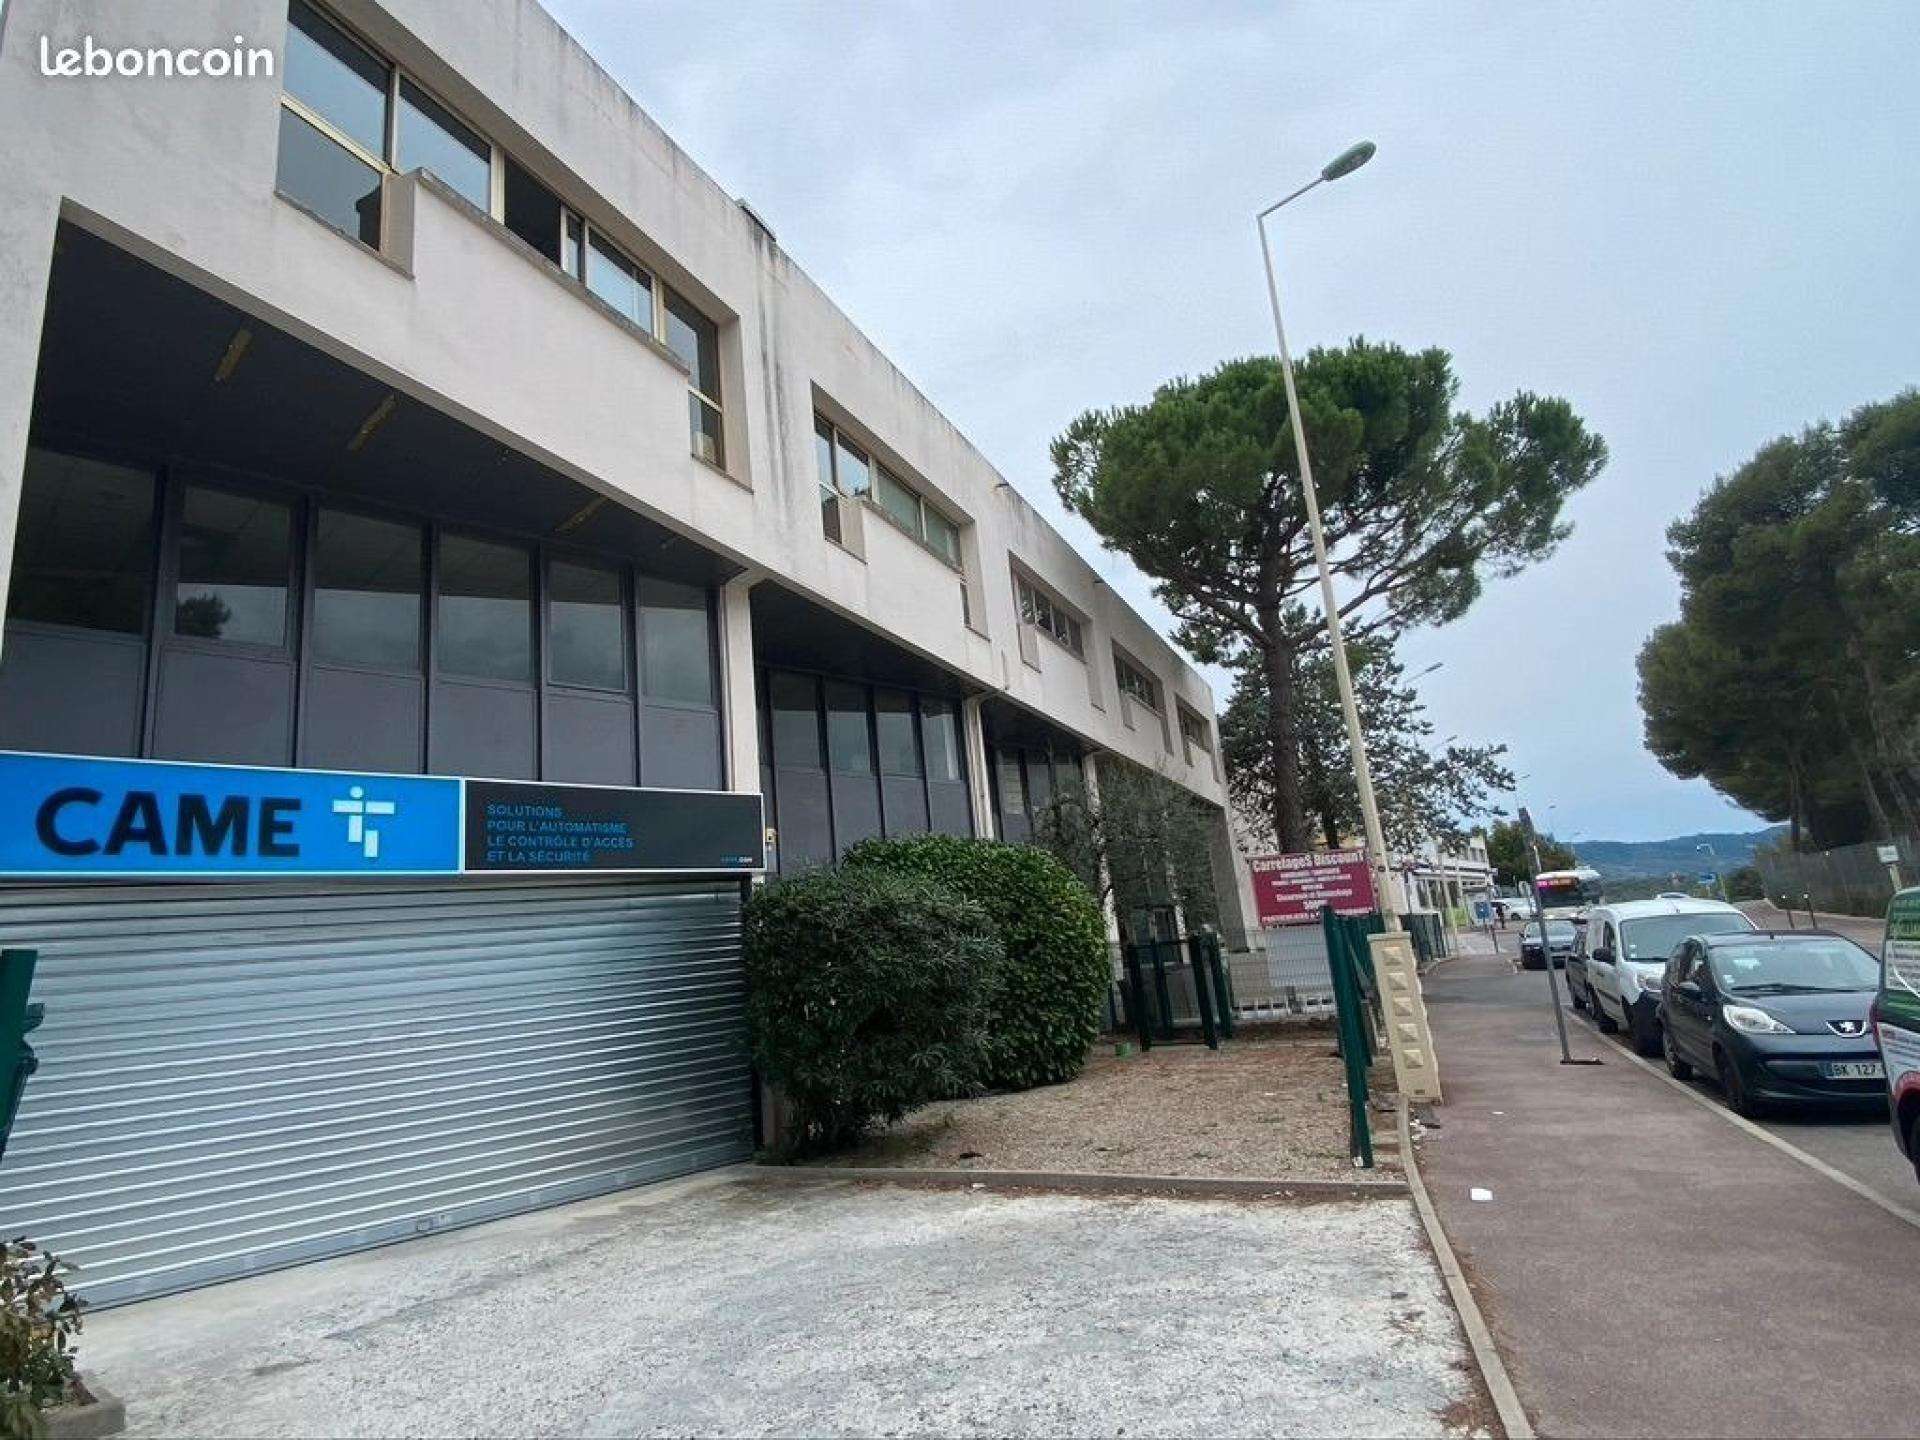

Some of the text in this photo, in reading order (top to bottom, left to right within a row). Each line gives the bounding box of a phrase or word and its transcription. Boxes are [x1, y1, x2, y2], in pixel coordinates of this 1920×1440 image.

[487, 804, 563, 818] SOLUTIONS
[35, 786, 301, 858] CAME
[487, 820, 629, 833] POUR L'AUTOMATISME
[487, 835, 505, 847] LE
[487, 850, 506, 862] ET
[508, 850, 526, 862] LA
